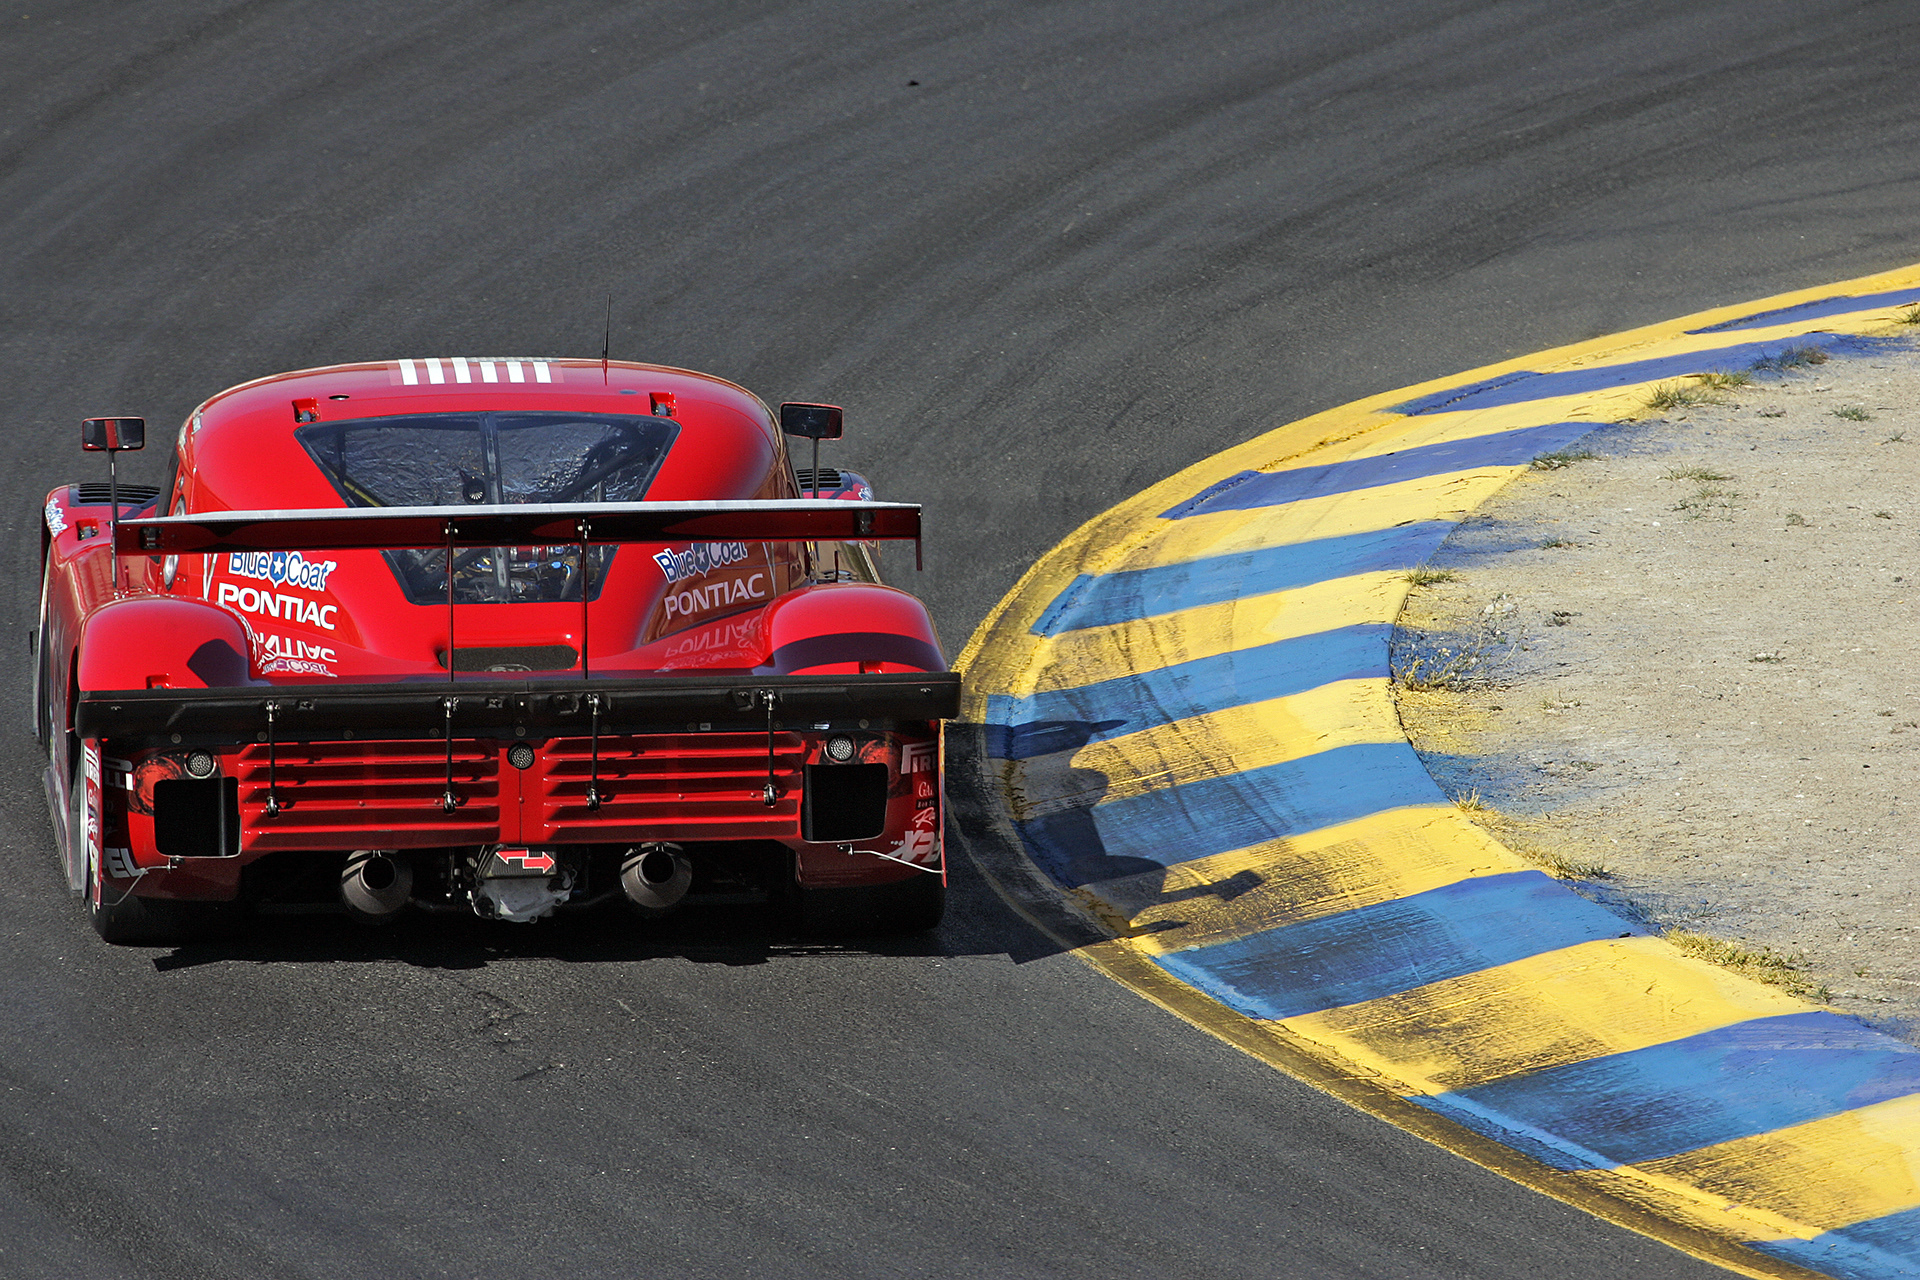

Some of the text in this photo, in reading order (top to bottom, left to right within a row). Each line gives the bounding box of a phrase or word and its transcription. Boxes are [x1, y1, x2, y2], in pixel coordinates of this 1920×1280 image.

[229, 551, 336, 591] Blue Coat
[652, 542, 749, 583] Blue Coat
[218, 582, 338, 630] PONTIAC
[664, 573, 765, 620] PONTIAC
